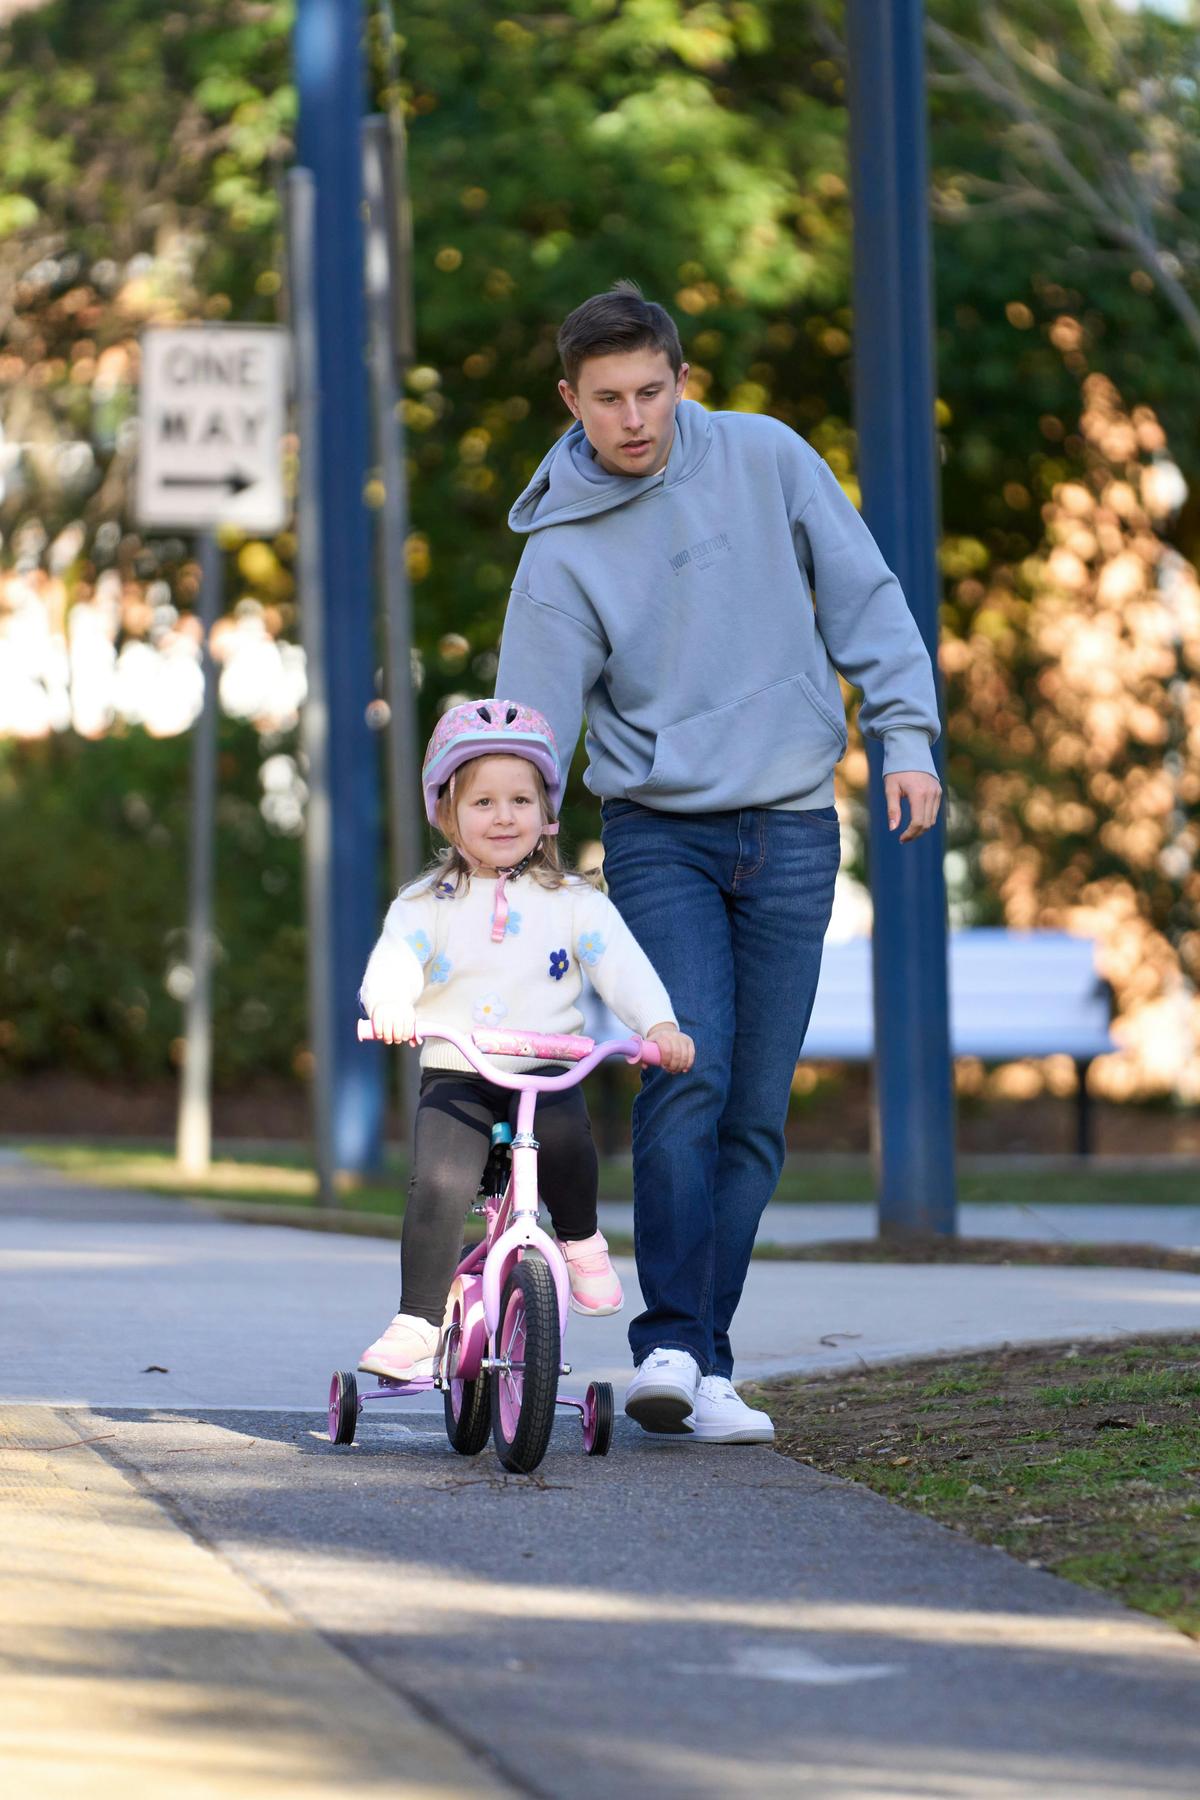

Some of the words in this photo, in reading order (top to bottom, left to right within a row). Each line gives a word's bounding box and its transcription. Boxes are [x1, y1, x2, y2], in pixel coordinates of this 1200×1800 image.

[162, 346, 266, 387] ONE
[158, 410, 266, 443] WAY
[669, 549, 692, 572] NOIR
